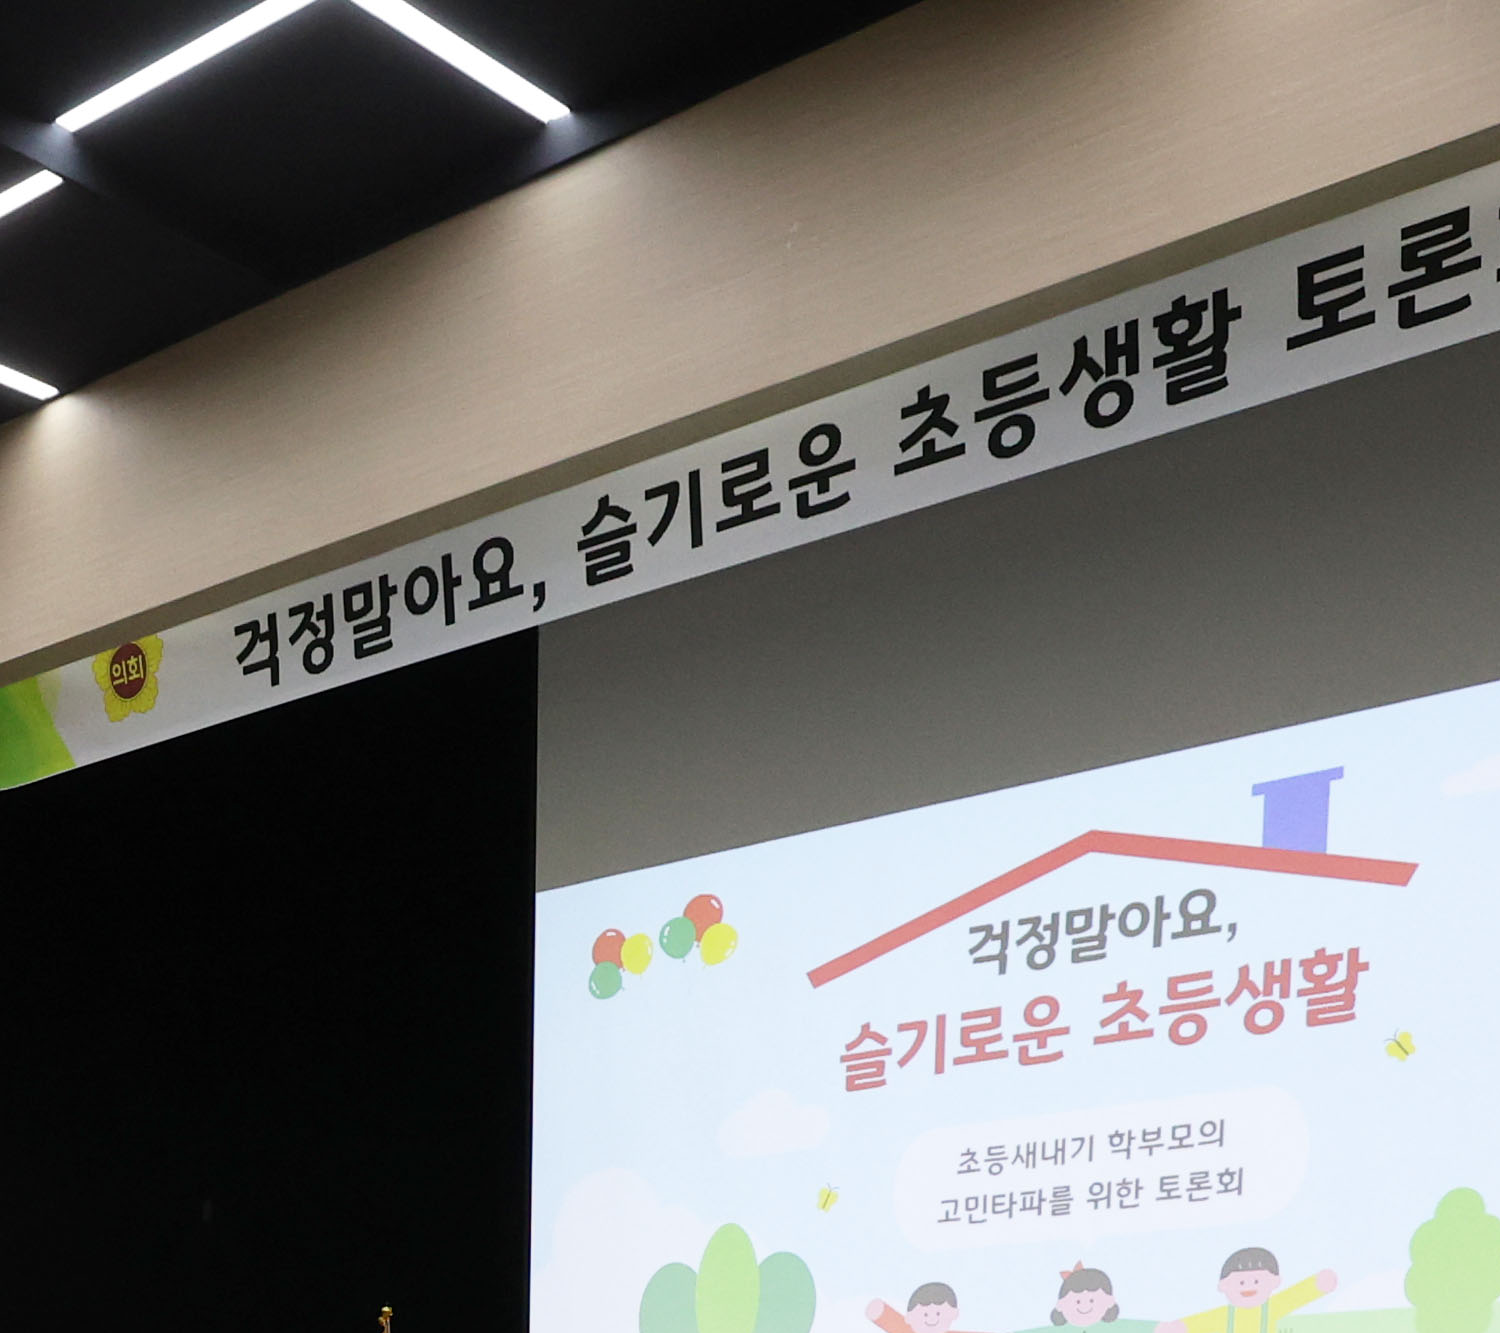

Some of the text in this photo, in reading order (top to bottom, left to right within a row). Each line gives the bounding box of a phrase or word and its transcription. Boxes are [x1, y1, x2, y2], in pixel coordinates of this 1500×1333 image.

[233, 535, 547, 688] 걱정말아요,
[577, 422, 858, 588] 슬기로운
[893, 287, 1242, 478] 초등생활
[111, 654, 144, 686] 의회
[967, 887, 1238, 976] 걱정말아요,
[839, 946, 1370, 1093] 슬기로운 초등생활
[955, 1117, 1226, 1177] 초등새내기 학부모의
[936, 1166, 1245, 1225] 고민타파를 위한 토론회
